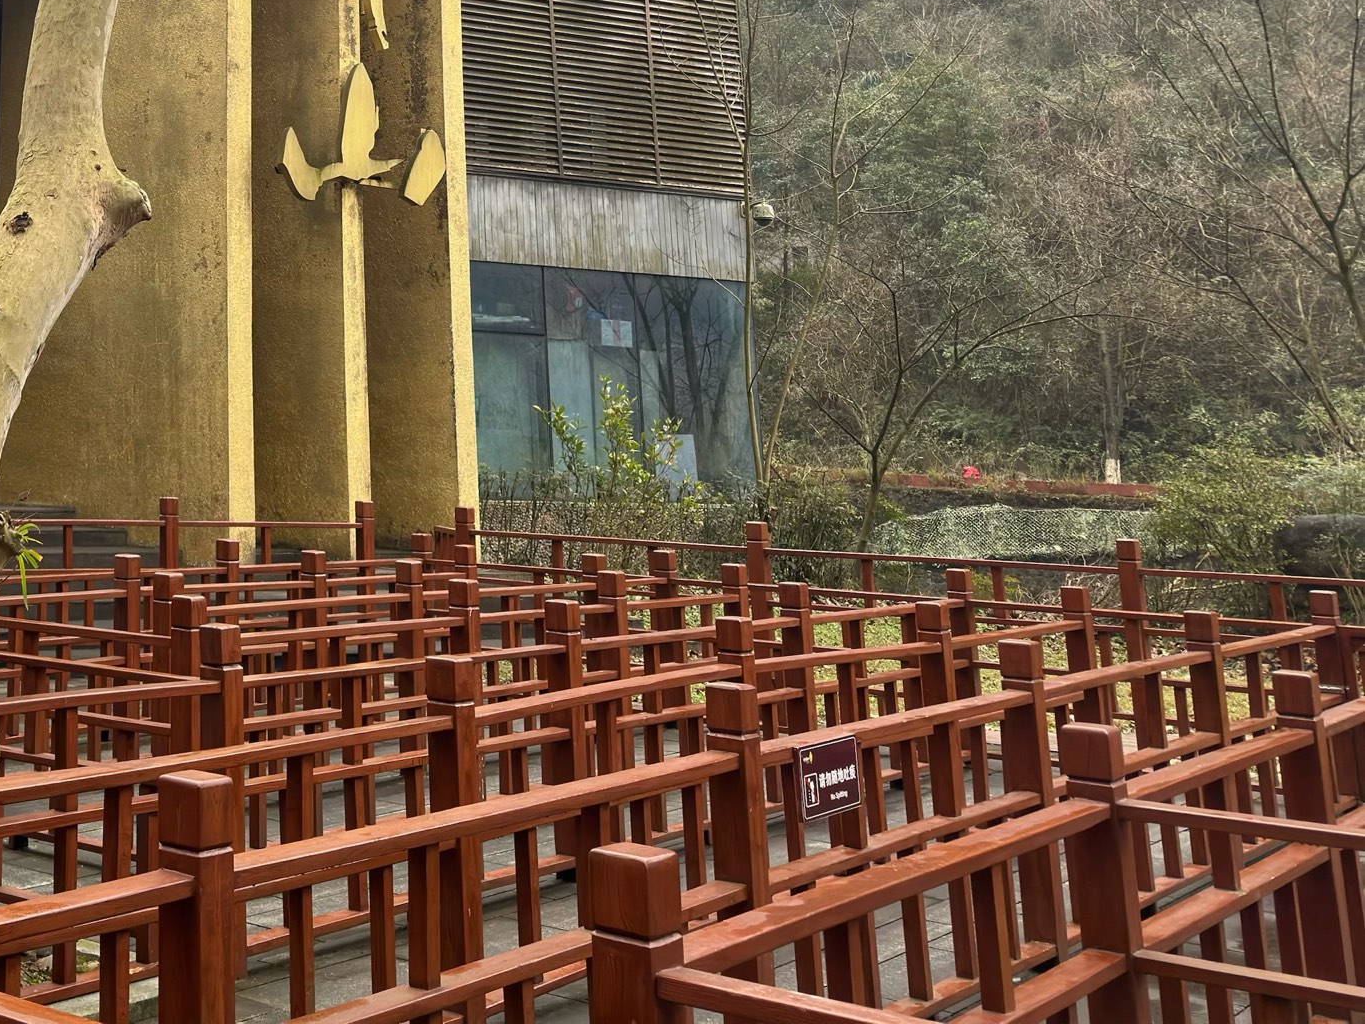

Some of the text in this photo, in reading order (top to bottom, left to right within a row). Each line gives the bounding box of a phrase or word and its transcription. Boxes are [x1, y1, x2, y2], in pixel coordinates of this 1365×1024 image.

[818, 764, 856, 788] 请勿随地吐痰
